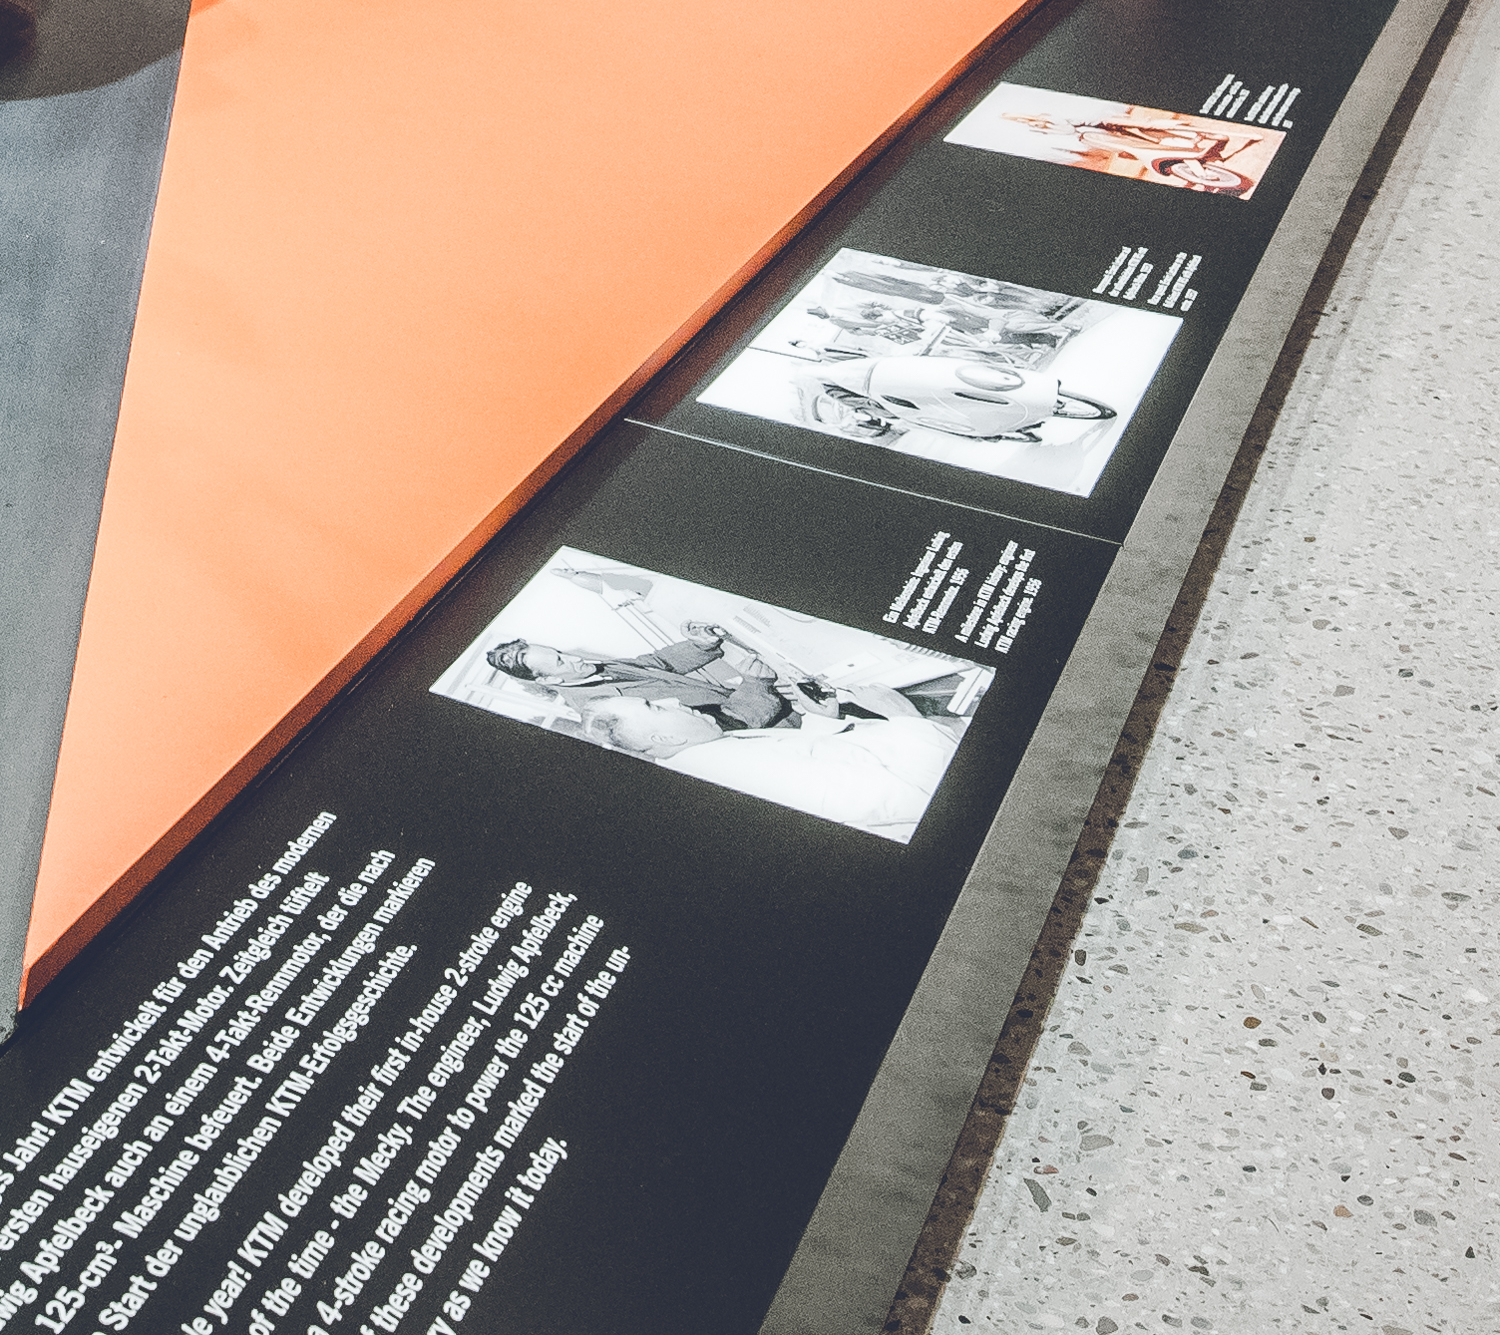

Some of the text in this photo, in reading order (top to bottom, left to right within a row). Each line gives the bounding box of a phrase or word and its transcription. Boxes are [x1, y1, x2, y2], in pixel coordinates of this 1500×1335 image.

[1, 1120, 57, 1173] Jahr!
[40, 1077, 97, 1126] KTM
[85, 999, 169, 1083] entwickelt
[151, 975, 188, 1005] für
[176, 947, 215, 980] den
[199, 897, 260, 952] Antrieb
[246, 871, 283, 900] des
[271, 810, 338, 876] modernen
[18, 1183, 116, 1286] Apfelbeck
[103, 1139, 154, 1189] auch
[142, 1114, 175, 1143] an
[163, 1061, 219, 1117] einem
[204, 930, 333, 1064] 4-Takt-Rennmotor,
[315, 902, 350, 932] der
[336, 881, 369, 907] die
[356, 848, 397, 886] nach
[37, 1081, 149, 1192] hauseigenen
[132, 983, 236, 1086] 2-Takt-Motor.
[217, 913, 295, 986] Zeitgleich
[278, 870, 331, 916] tüftelt
[97, 943, 419, 1332] Start der unglaublichen KTM-Erfolgsgeschichte.
[111, 1149, 201, 1240] Maschine
[183, 1075, 264, 1152] befeuert.
[245, 1024, 302, 1075] Beide
[283, 921, 385, 1028] Entwicklungen
[371, 856, 437, 925] markieren
[202, 880, 534, 1327] year! KTM developed their first in-house 2-stroke engine
[259, 1276, 303, 1318] the
[286, 1229, 336, 1280] time
[328, 1182, 370, 1220] the
[351, 1121, 415, 1187] Mecky.
[395, 1084, 438, 1121] The
[426, 1014, 493, 1089] engineer,
[471, 957, 531, 1017] Ludwig
[509, 890, 579, 965] Apfelbeck,
[441, 1136, 569, 1323] as we know it today.
